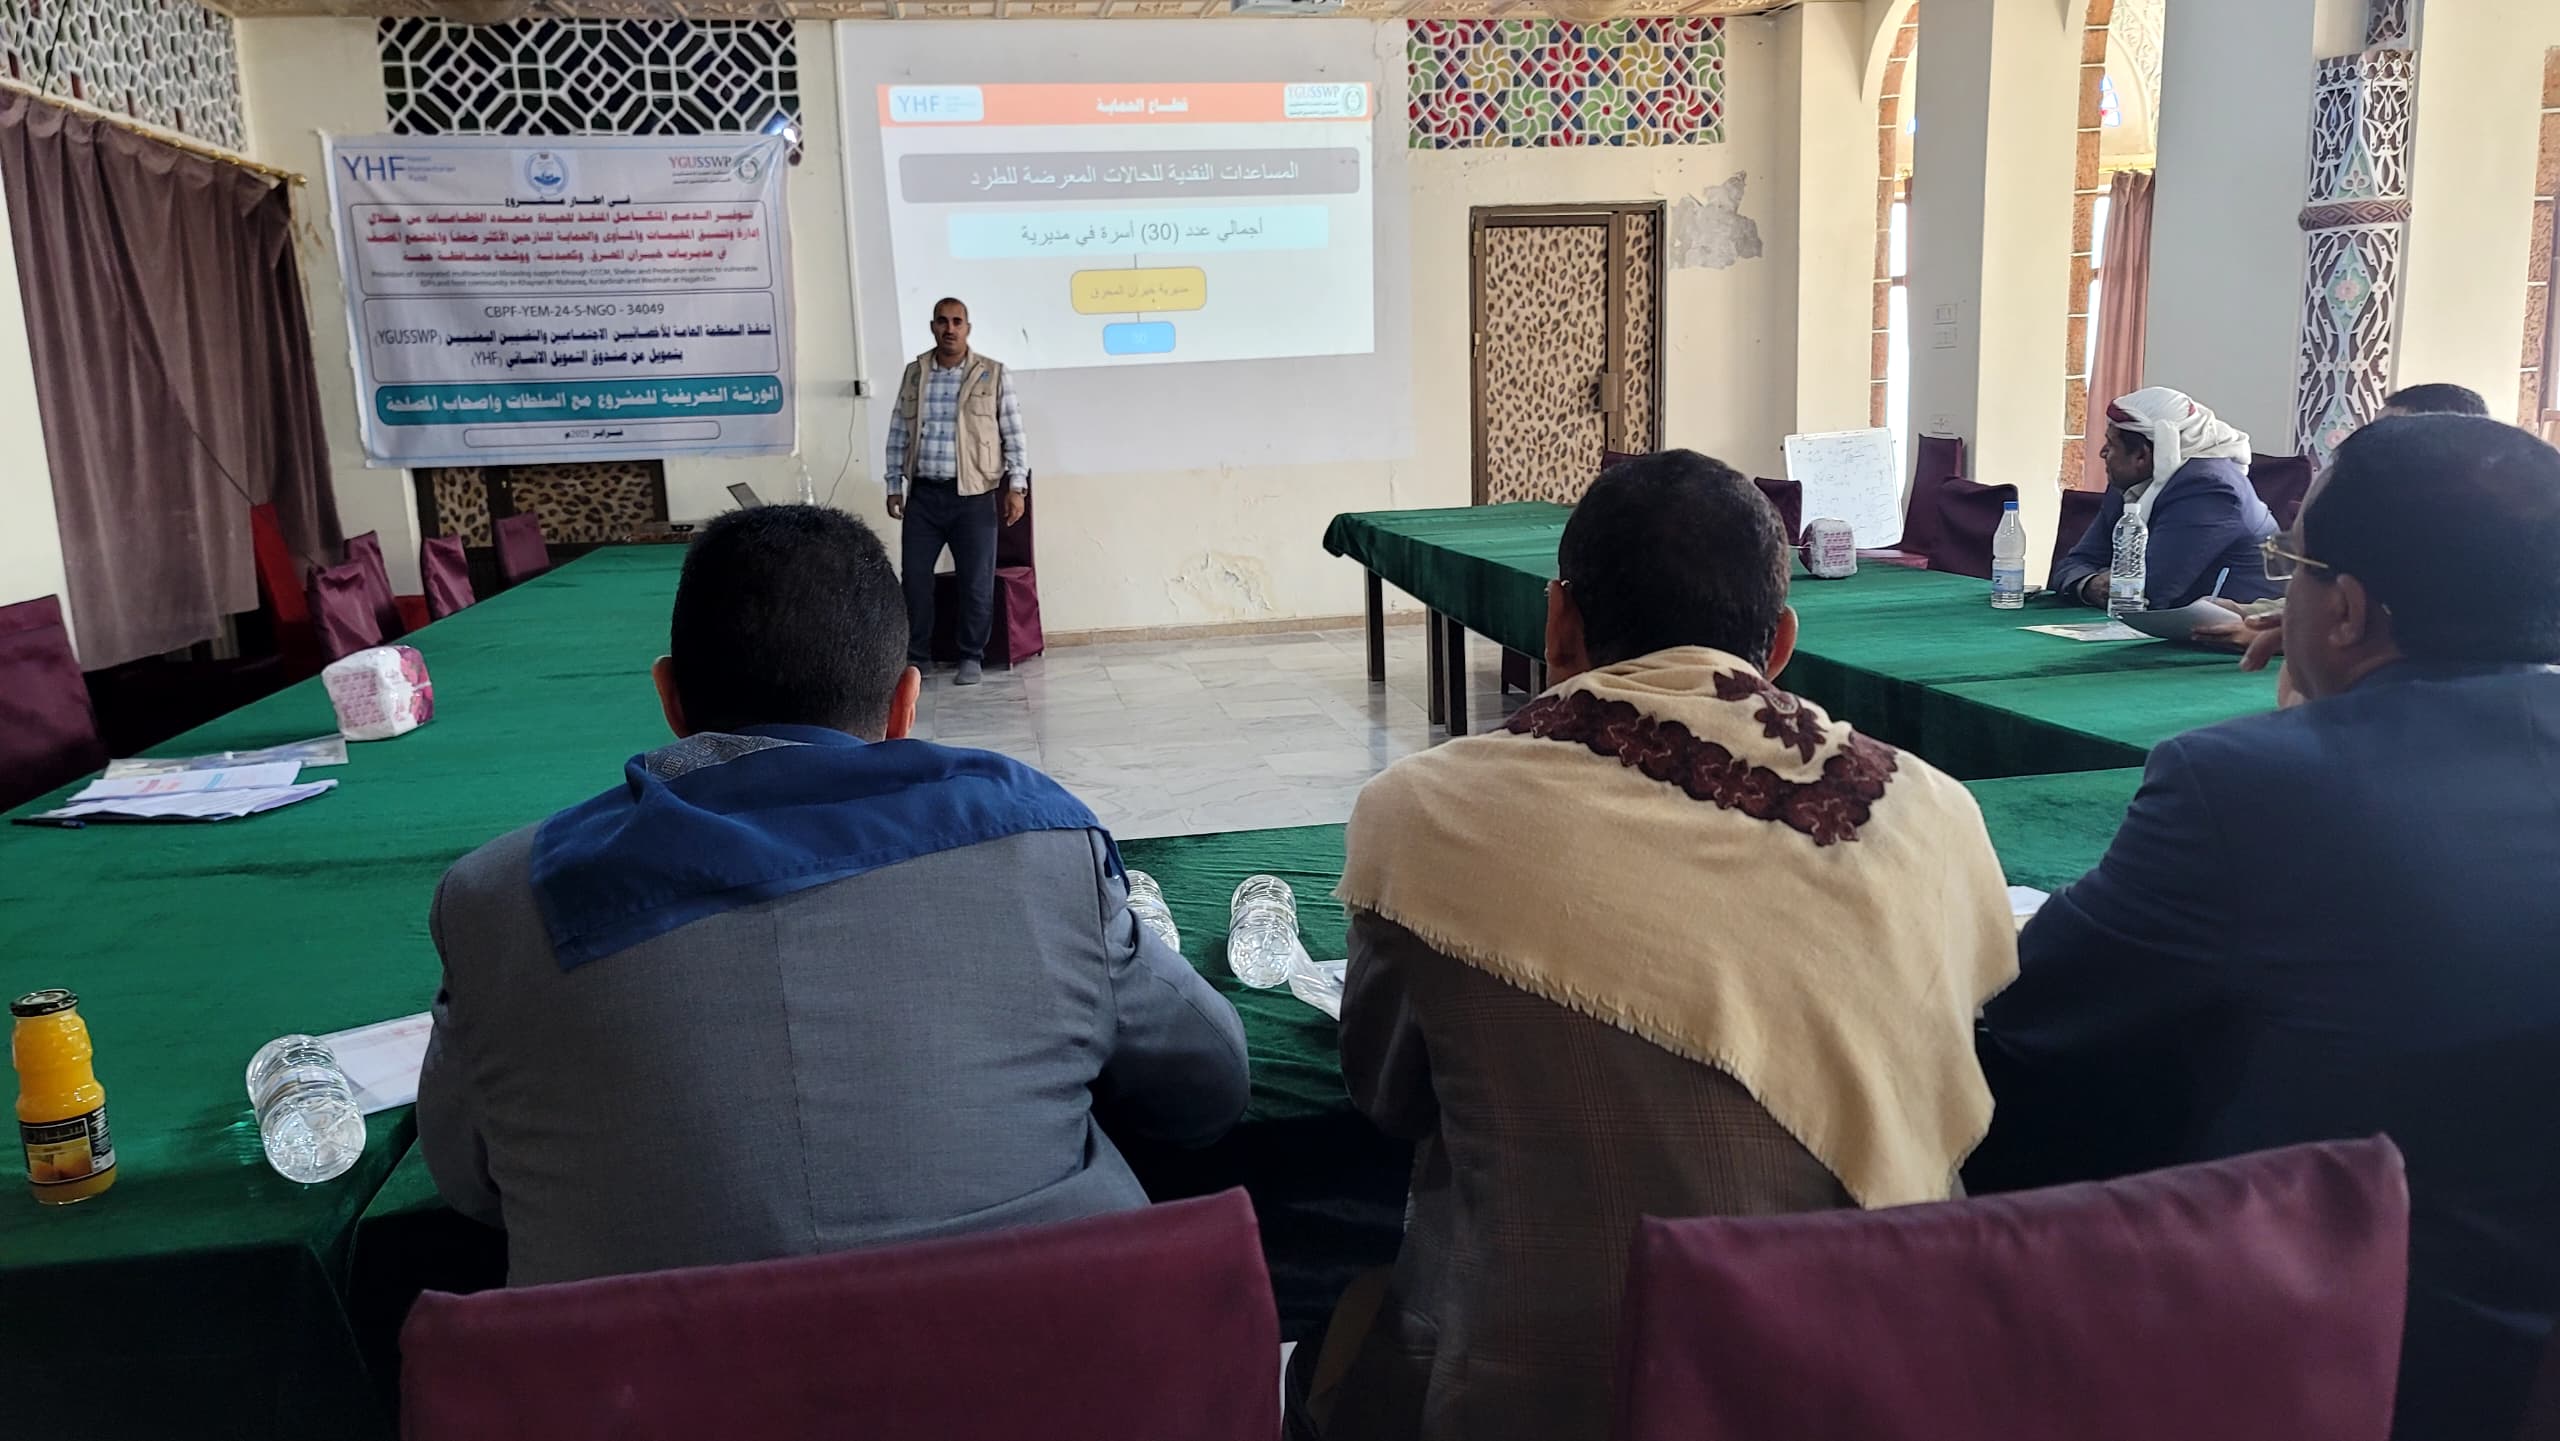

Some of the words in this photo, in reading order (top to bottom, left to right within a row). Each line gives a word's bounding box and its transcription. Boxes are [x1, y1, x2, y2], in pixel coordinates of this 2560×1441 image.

[897, 95, 940, 113] YHF
[341, 155, 405, 181] YHF
[669, 155, 732, 168] YGUSSWP
[1220, 160, 1299, 179] المساعدات
[971, 167, 1018, 190] للطرد
[1023, 166, 1097, 189] المعرضة
[1103, 164, 1164, 184] للحالات
[1167, 164, 1214, 185] النقدية
[505, 196, 565, 208] مشروع
[613, 209, 667, 224] المتكامل
[671, 209, 712, 222] الدعم
[1021, 224, 1070, 246] مديرية
[1075, 225, 1096, 246] في
[1101, 220, 1134, 244] أسرة
[1140, 223, 1180, 245] (30)
[1185, 225, 1210, 237] عدد
[485, 304, 616, 318] CBPF-YEM-24-S-NGO
[627, 303, 664, 316] 34049
[446, 330, 496, 346] اليمنيين
[499, 329, 547, 345] والنفسيين
[673, 325, 703, 338] العامة
[705, 323, 744, 337] المنظمة
[551, 350, 588, 367] التمويل
[591, 349, 627, 366] صندوق
[631, 353, 645, 365] من
[649, 348, 683, 364] بتمويل
[386, 394, 437, 412] المصلحة
[505, 391, 566, 409] السلطات
[571, 392, 592, 411] مع
[598, 388, 657, 410] للمشروع
[661, 386, 728, 408] التعريفية
[732, 385, 779, 404] الورشة
